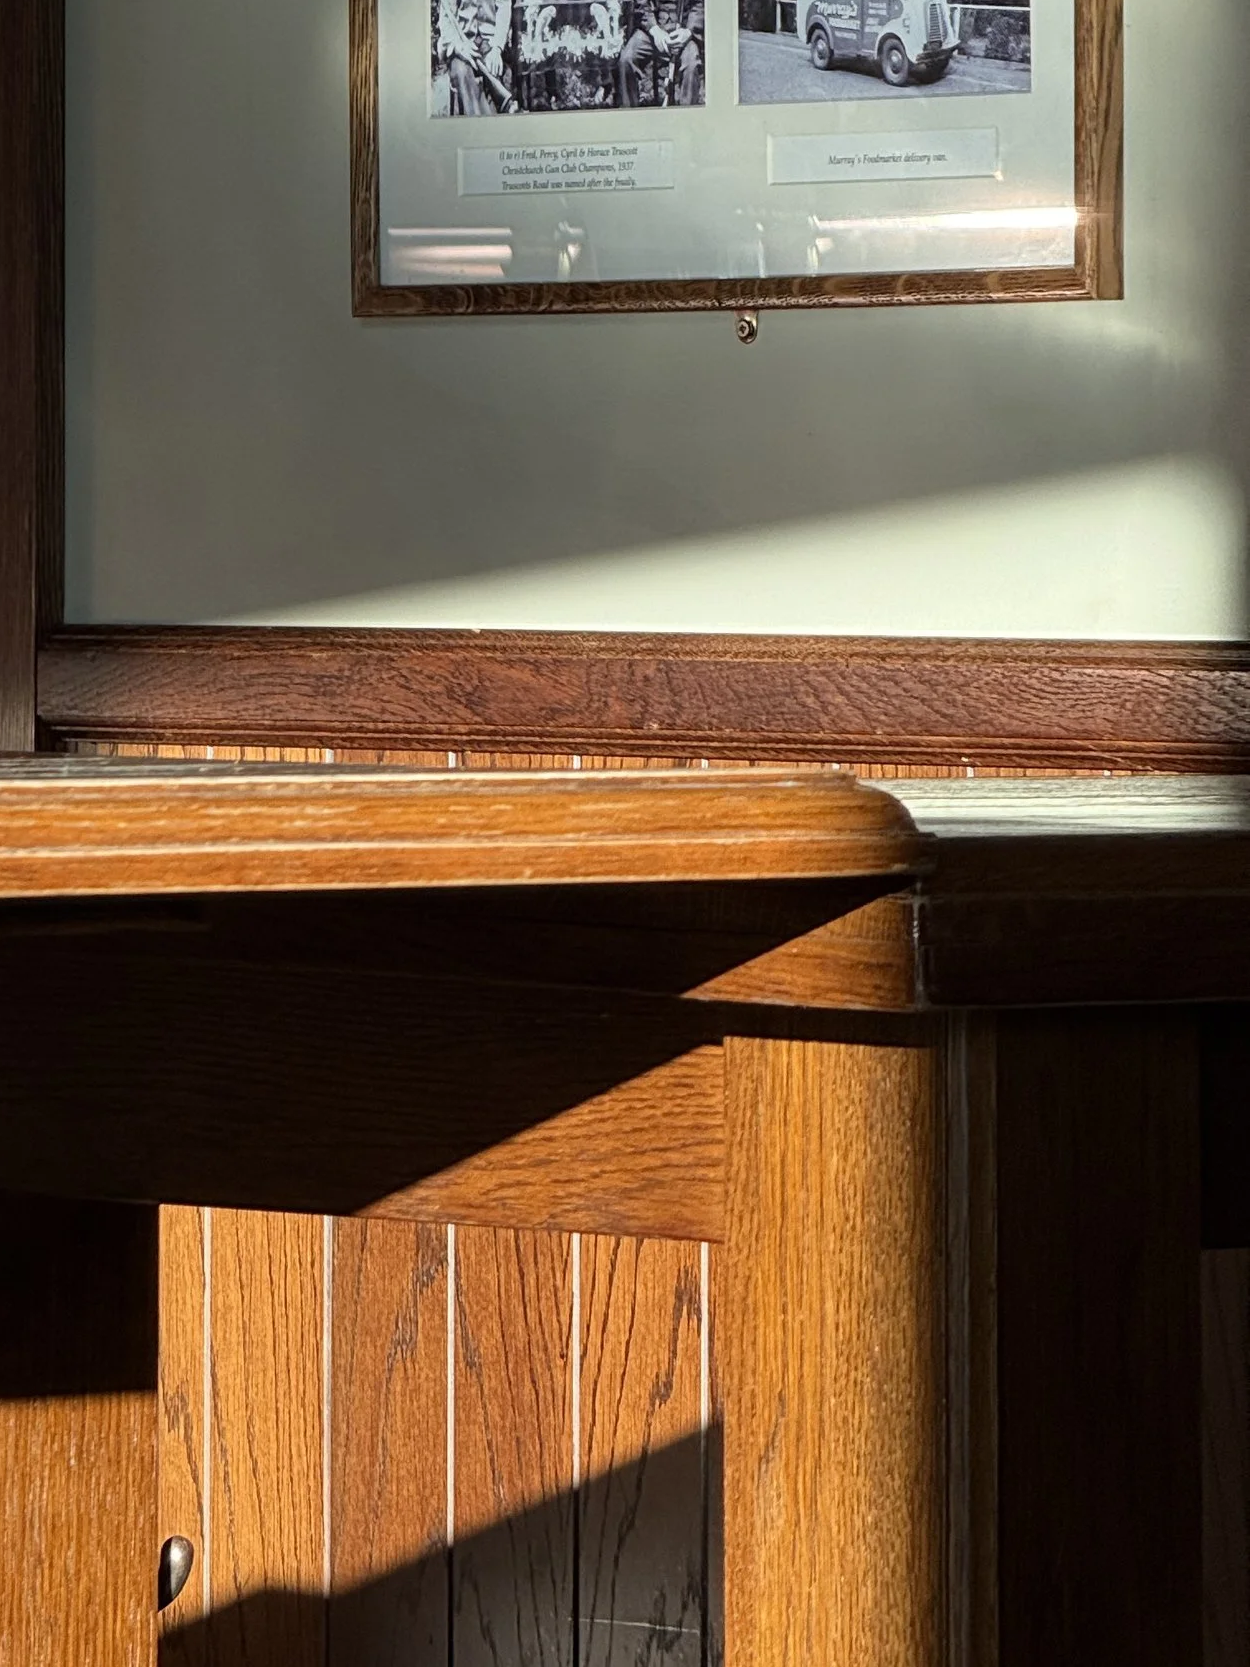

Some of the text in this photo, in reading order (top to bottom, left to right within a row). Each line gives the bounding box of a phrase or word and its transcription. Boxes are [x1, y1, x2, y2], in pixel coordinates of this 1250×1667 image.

[560, 147, 578, 161] Cyril
[578, 148, 586, 158] &
[587, 145, 610, 157] Horace
[611, 144, 638, 156] Truscott
[829, 153, 861, 167] Murray's
[863, 152, 902, 164] Foodmarket
[903, 152, 931, 165] delivery
[502, 164, 543, 176] Christchurch
[545, 163, 560, 174] Gun
[561, 162, 577, 173] Club
[533, 179, 549, 189] Road
[551, 180, 563, 189] was
[564, 178, 586, 188] named
[587, 176, 603, 189] after
[603, 176, 613, 187] the
